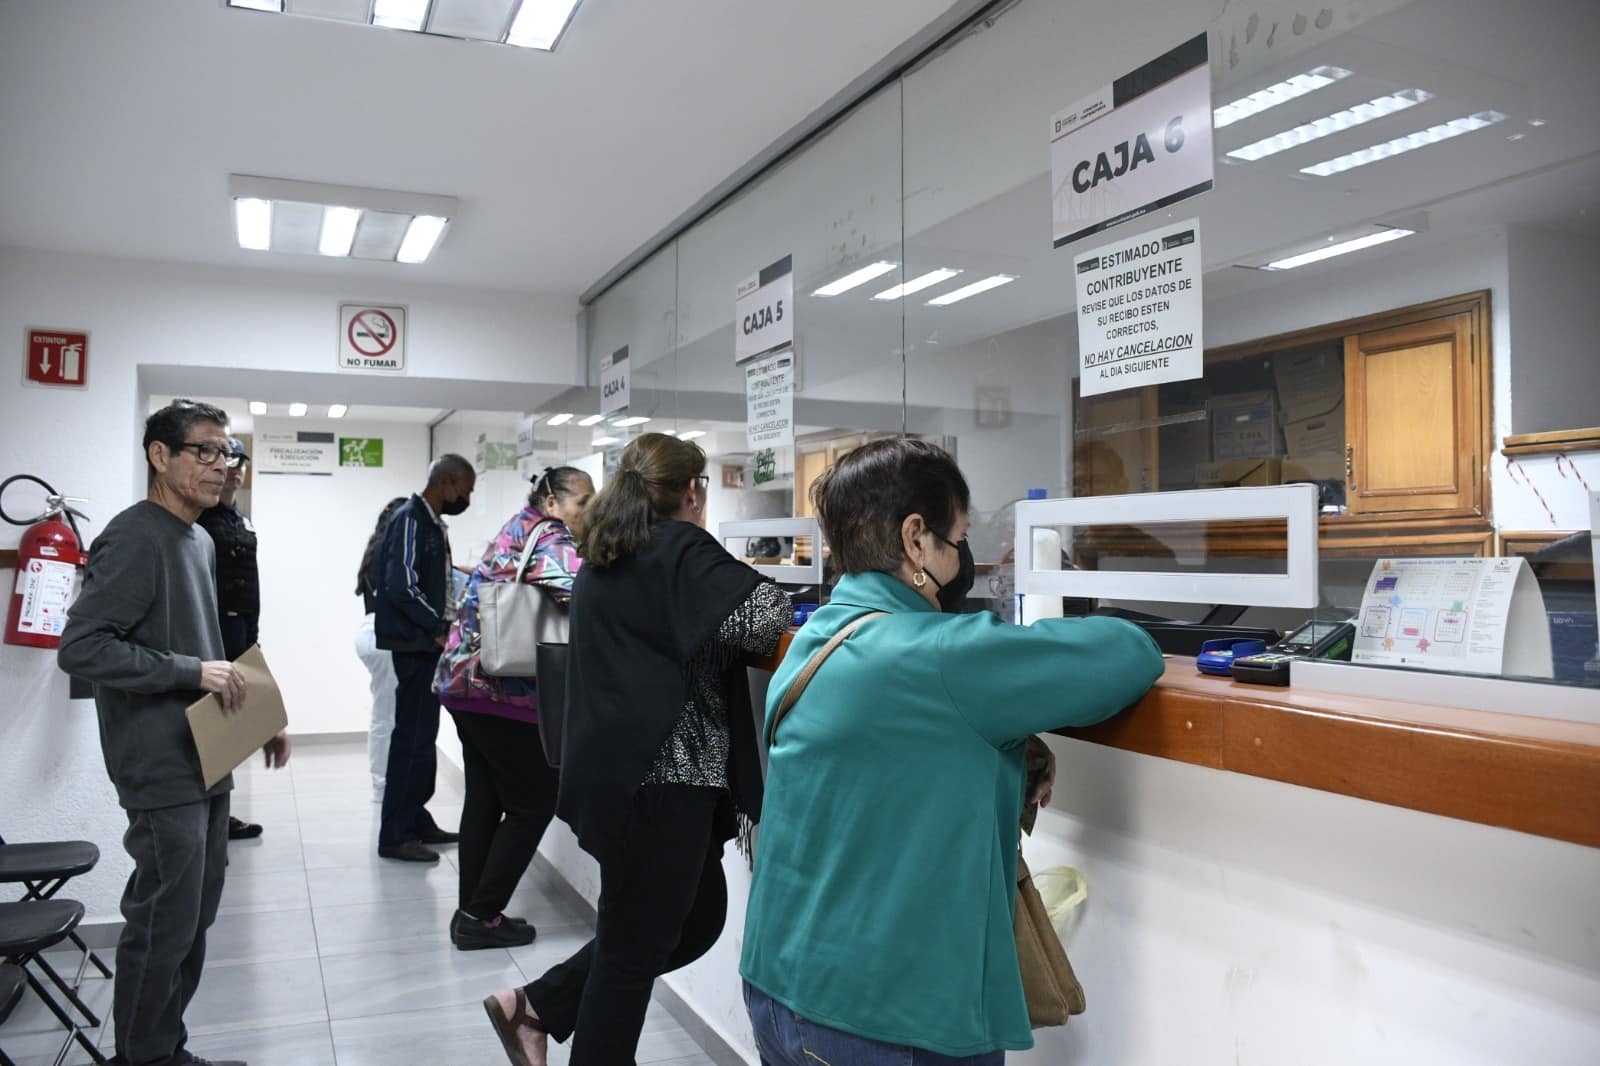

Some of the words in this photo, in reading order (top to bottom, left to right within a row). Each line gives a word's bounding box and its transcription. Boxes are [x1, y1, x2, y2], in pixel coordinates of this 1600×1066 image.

[1072, 132, 1155, 194] CAJA
[1164, 115, 1185, 154] 6
[1101, 241, 1160, 270] ESTIMADO
[1086, 257, 1183, 296] CONTRIBUYENTE
[1081, 299, 1107, 315] REVISE
[1108, 294, 1124, 309] QUE
[1126, 290, 1143, 304] LOS
[1145, 282, 1176, 298] DATOS
[1178, 278, 1192, 290] DE
[743, 305, 773, 336] CAJA
[776, 299, 783, 321] 5
[1097, 315, 1108, 327] SU
[1109, 307, 1139, 324] RECIBO
[1141, 301, 1170, 316] ESTEN
[33, 336, 67, 344] EXTINTOR
[1106, 319, 1159, 340] CORRECTOS,
[347, 357, 361, 366] NO
[364, 359, 397, 368] FUMAR
[1084, 353, 1096, 366] NO
[1097, 347, 1117, 364] HAY
[1117, 333, 1193, 358] CANCELACION
[1100, 368, 1109, 379] AL
[1110, 364, 1122, 377] DIA
[1124, 357, 1169, 375] SIGUIENTE
